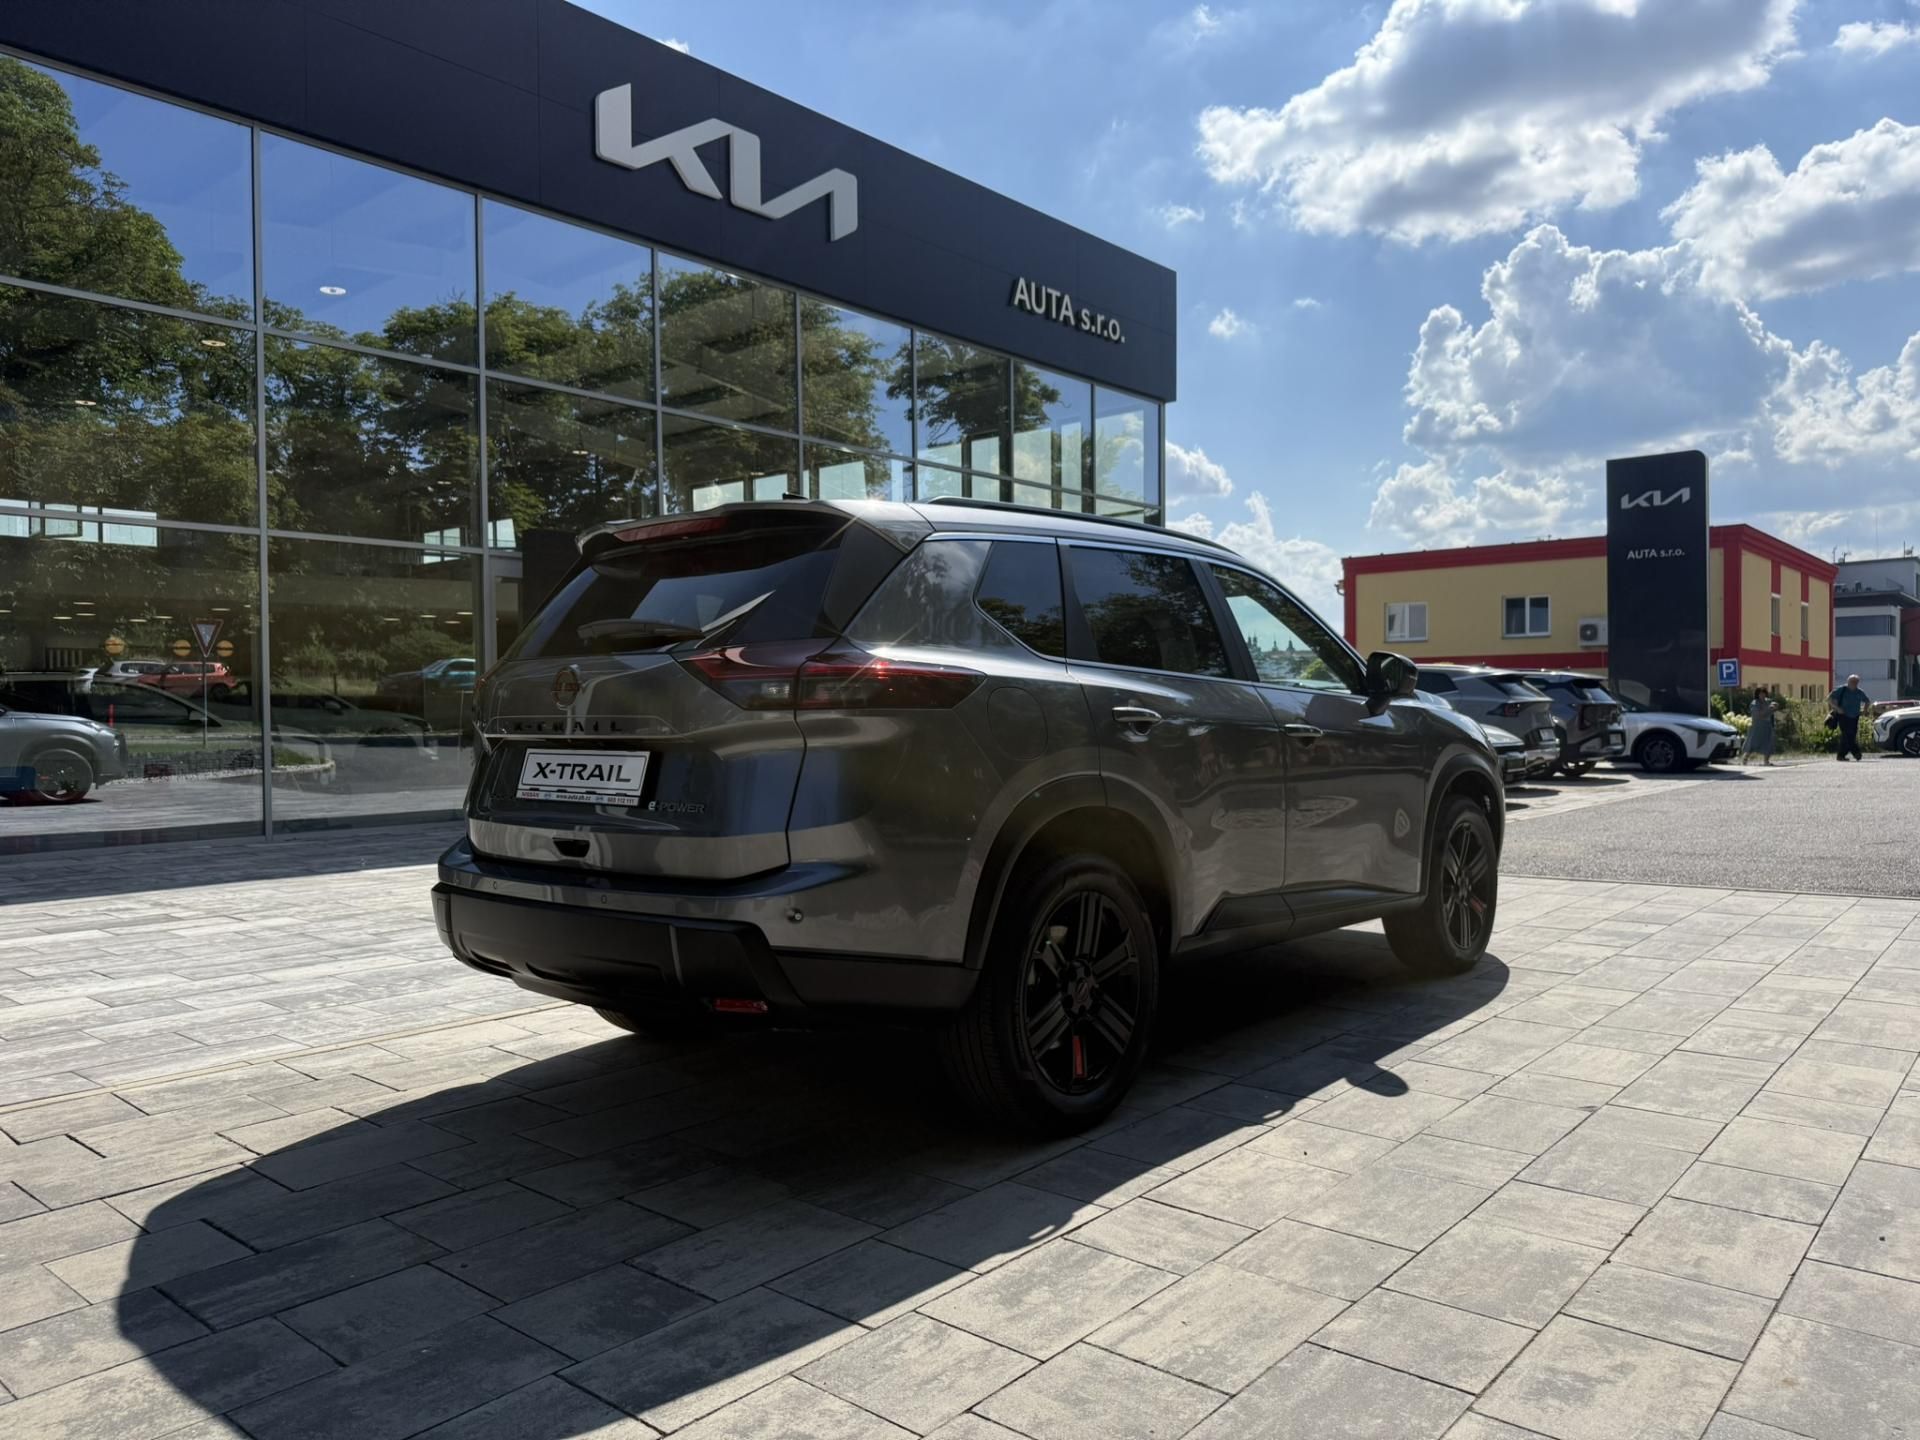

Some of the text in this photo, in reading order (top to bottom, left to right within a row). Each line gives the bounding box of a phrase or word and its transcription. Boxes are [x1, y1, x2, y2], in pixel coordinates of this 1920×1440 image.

[1012, 277, 1127, 343] AUTA s.r.o.
[1626, 548, 1685, 560] AUTA s.r.o.
[1722, 663, 1735, 679] P
[532, 761, 632, 784] X-TRAIL
